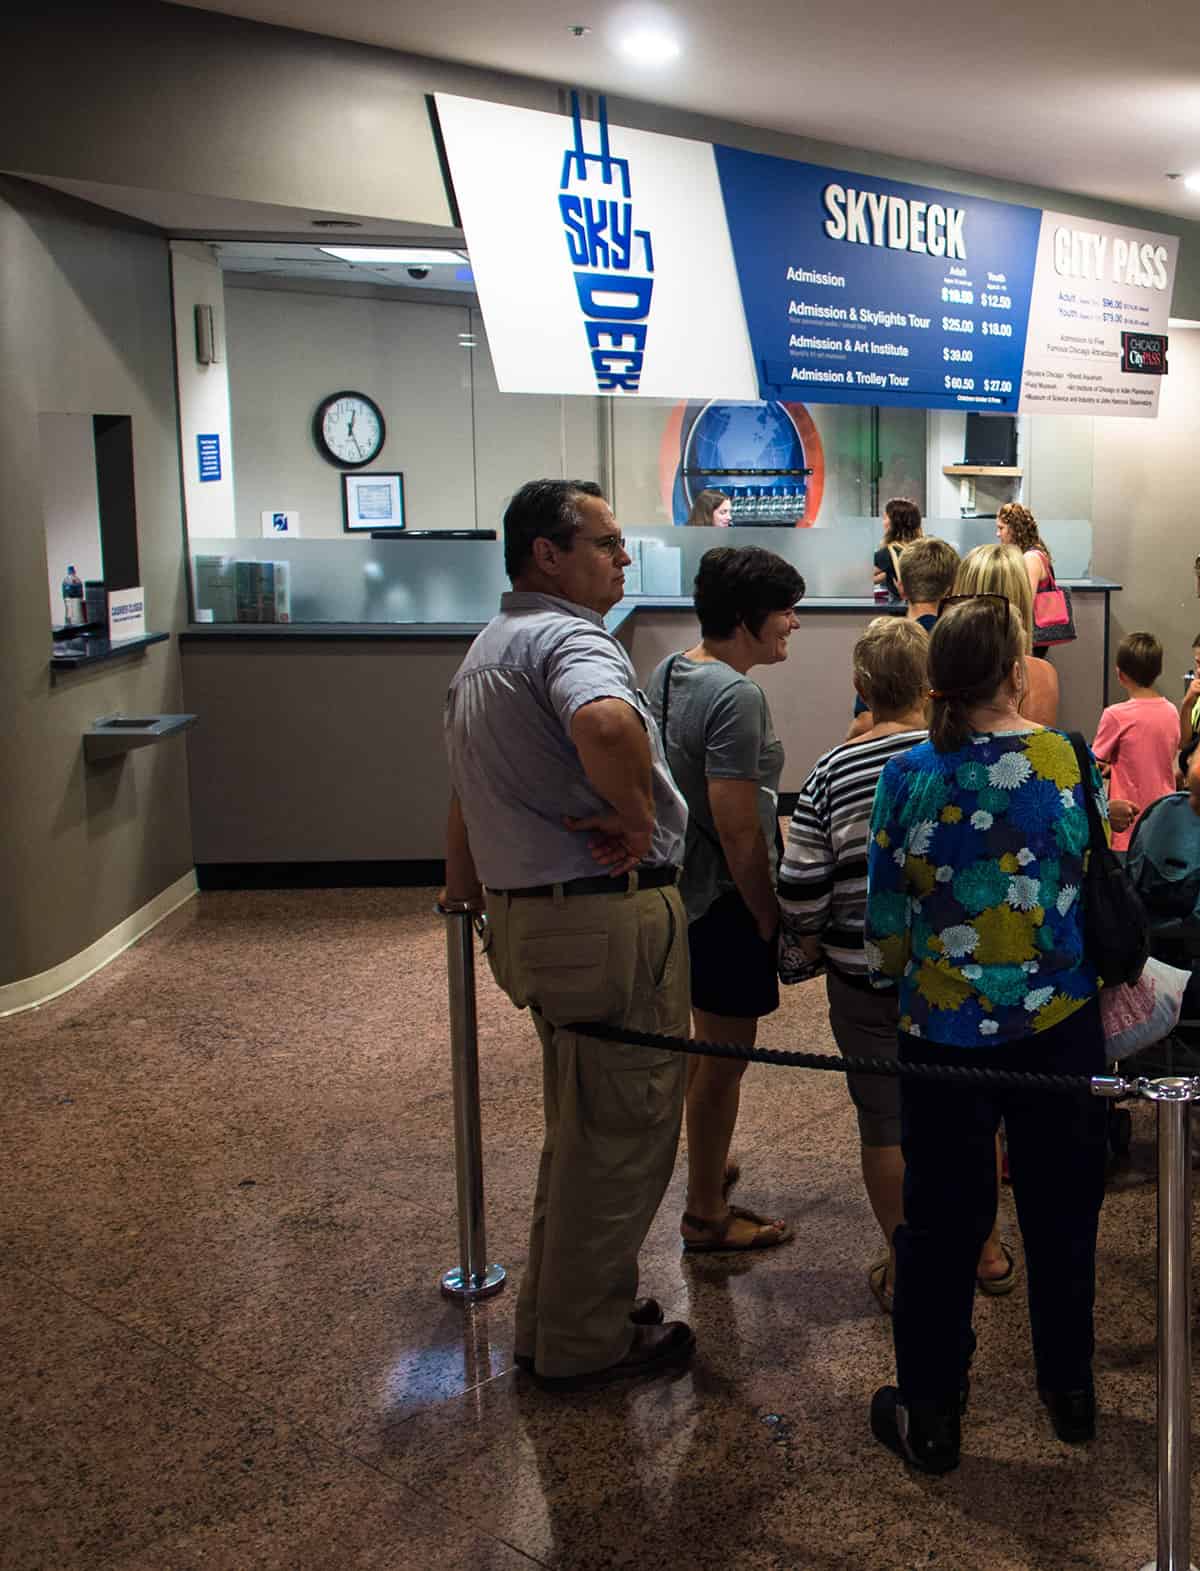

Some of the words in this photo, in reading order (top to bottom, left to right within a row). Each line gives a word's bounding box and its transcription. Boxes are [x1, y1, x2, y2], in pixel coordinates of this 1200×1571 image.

[558, 193, 633, 270] SKY
[825, 184, 967, 260] SKYDECK
[1054, 227, 1106, 280] CITY
[1112, 238, 1168, 290] PASS
[787, 267, 845, 288] Admission
[789, 301, 847, 320] Admission
[849, 308, 857, 321] &
[860, 309, 907, 327] Skylights
[908, 314, 931, 328] Tour
[573, 272, 654, 393] DECK
[789, 335, 843, 351] Admission
[845, 340, 852, 352] &
[854, 341, 869, 353] Art
[871, 342, 909, 356] Institute
[1129, 338, 1161, 352] CHICAGO
[791, 368, 844, 383] Admission
[847, 371, 853, 383] &
[856, 372, 887, 387] Trolley
[888, 373, 909, 386] Tour
